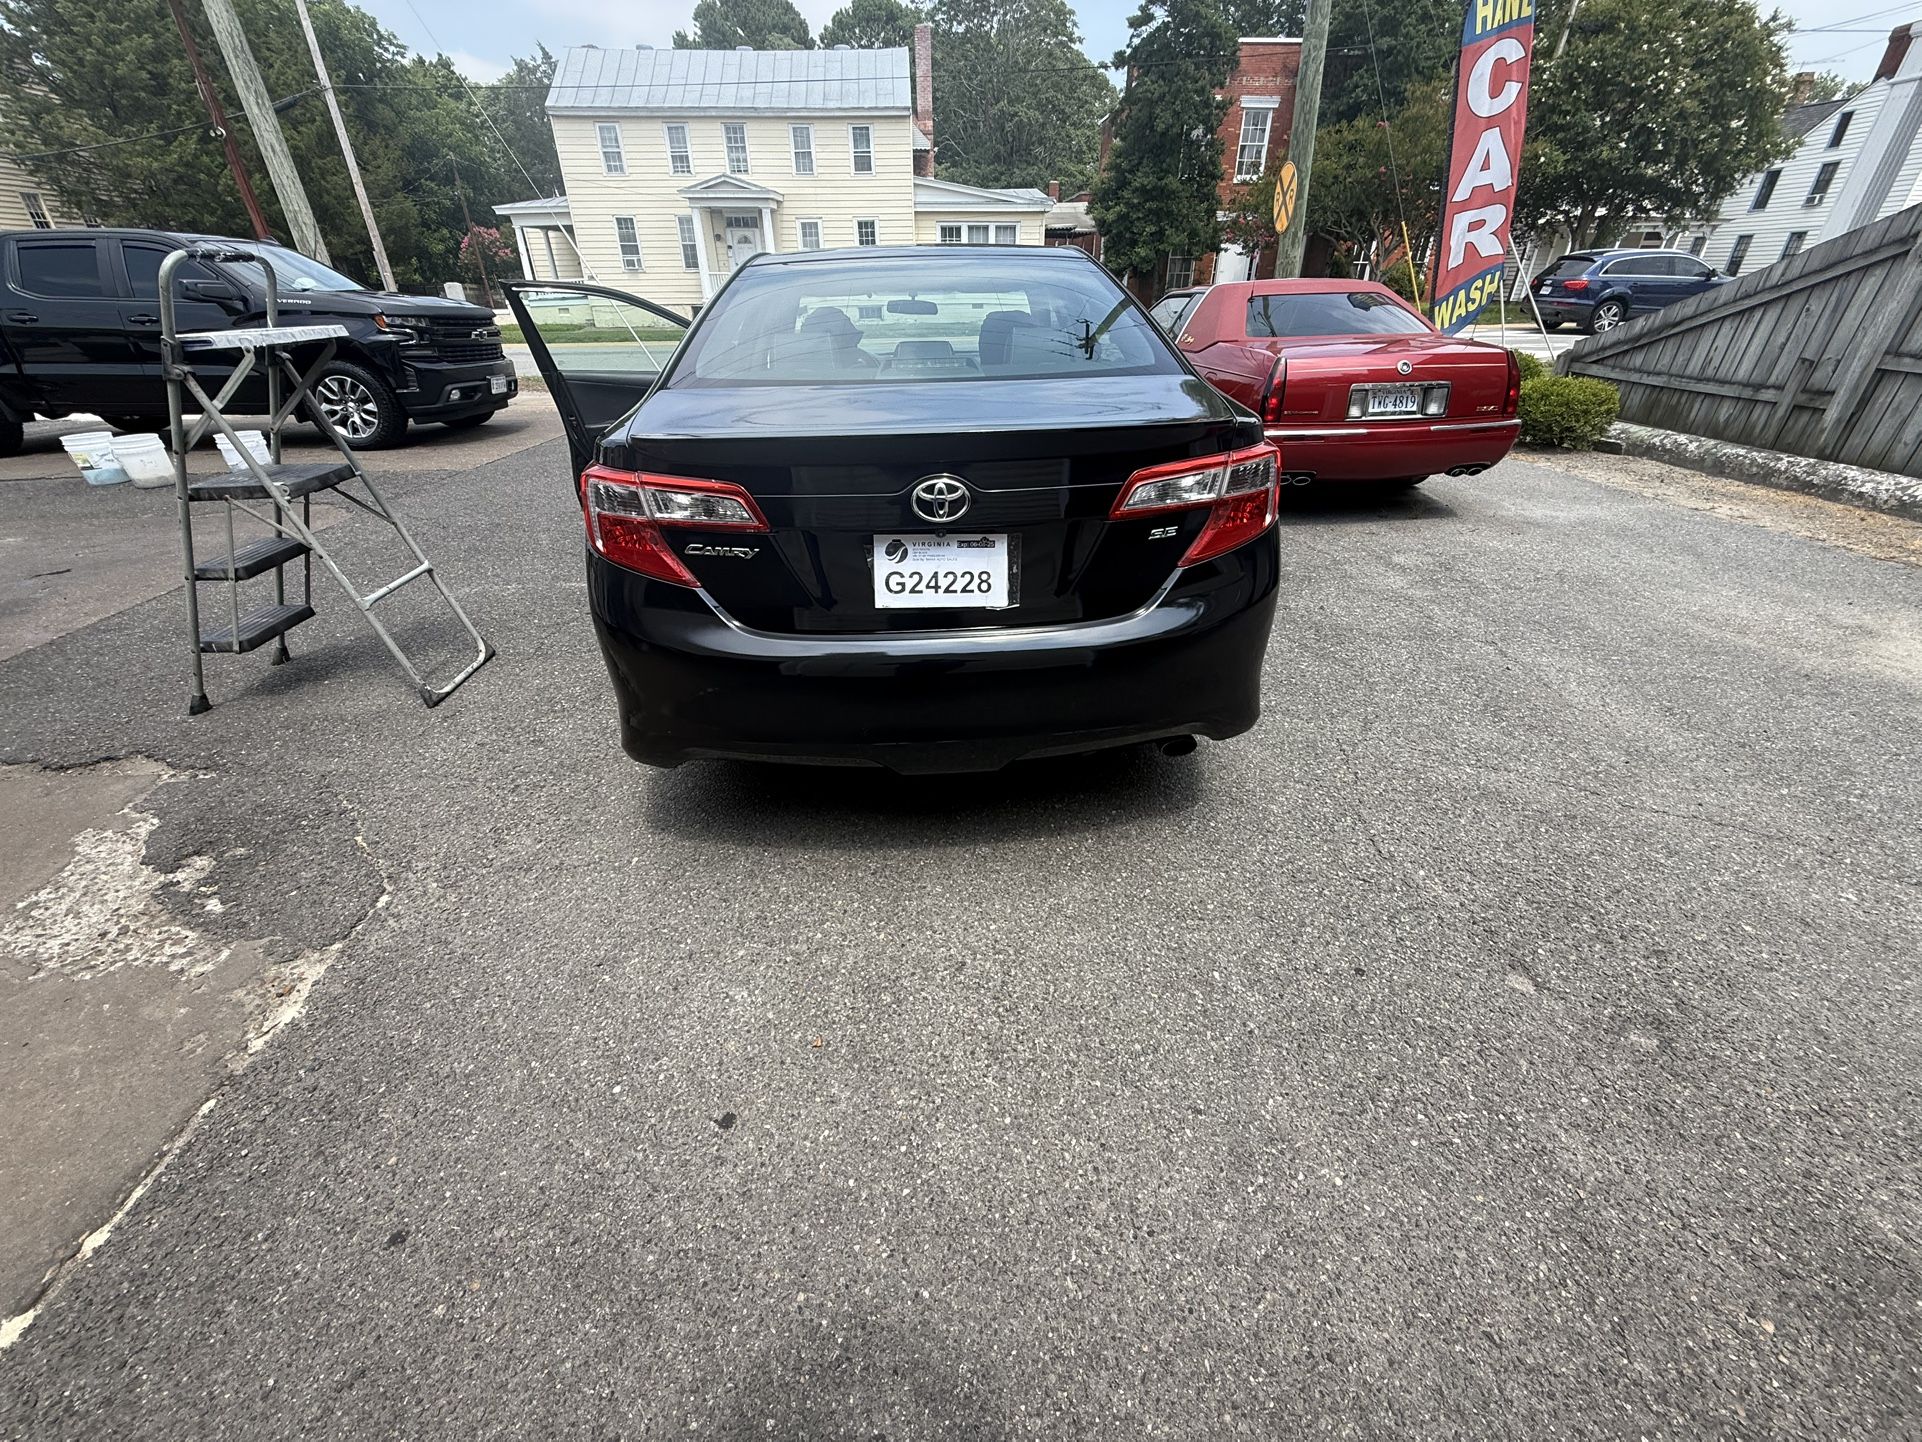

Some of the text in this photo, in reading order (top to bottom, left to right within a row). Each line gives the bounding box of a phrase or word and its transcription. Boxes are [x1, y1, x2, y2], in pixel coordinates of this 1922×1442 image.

[1447, 37, 1526, 272] CAR
[1434, 270, 1501, 331] WASH
[1371, 395, 1416, 409] TWG-4819
[1148, 526, 1178, 540] SE
[684, 544, 760, 559] CAMRY
[884, 571, 992, 595] G24228
